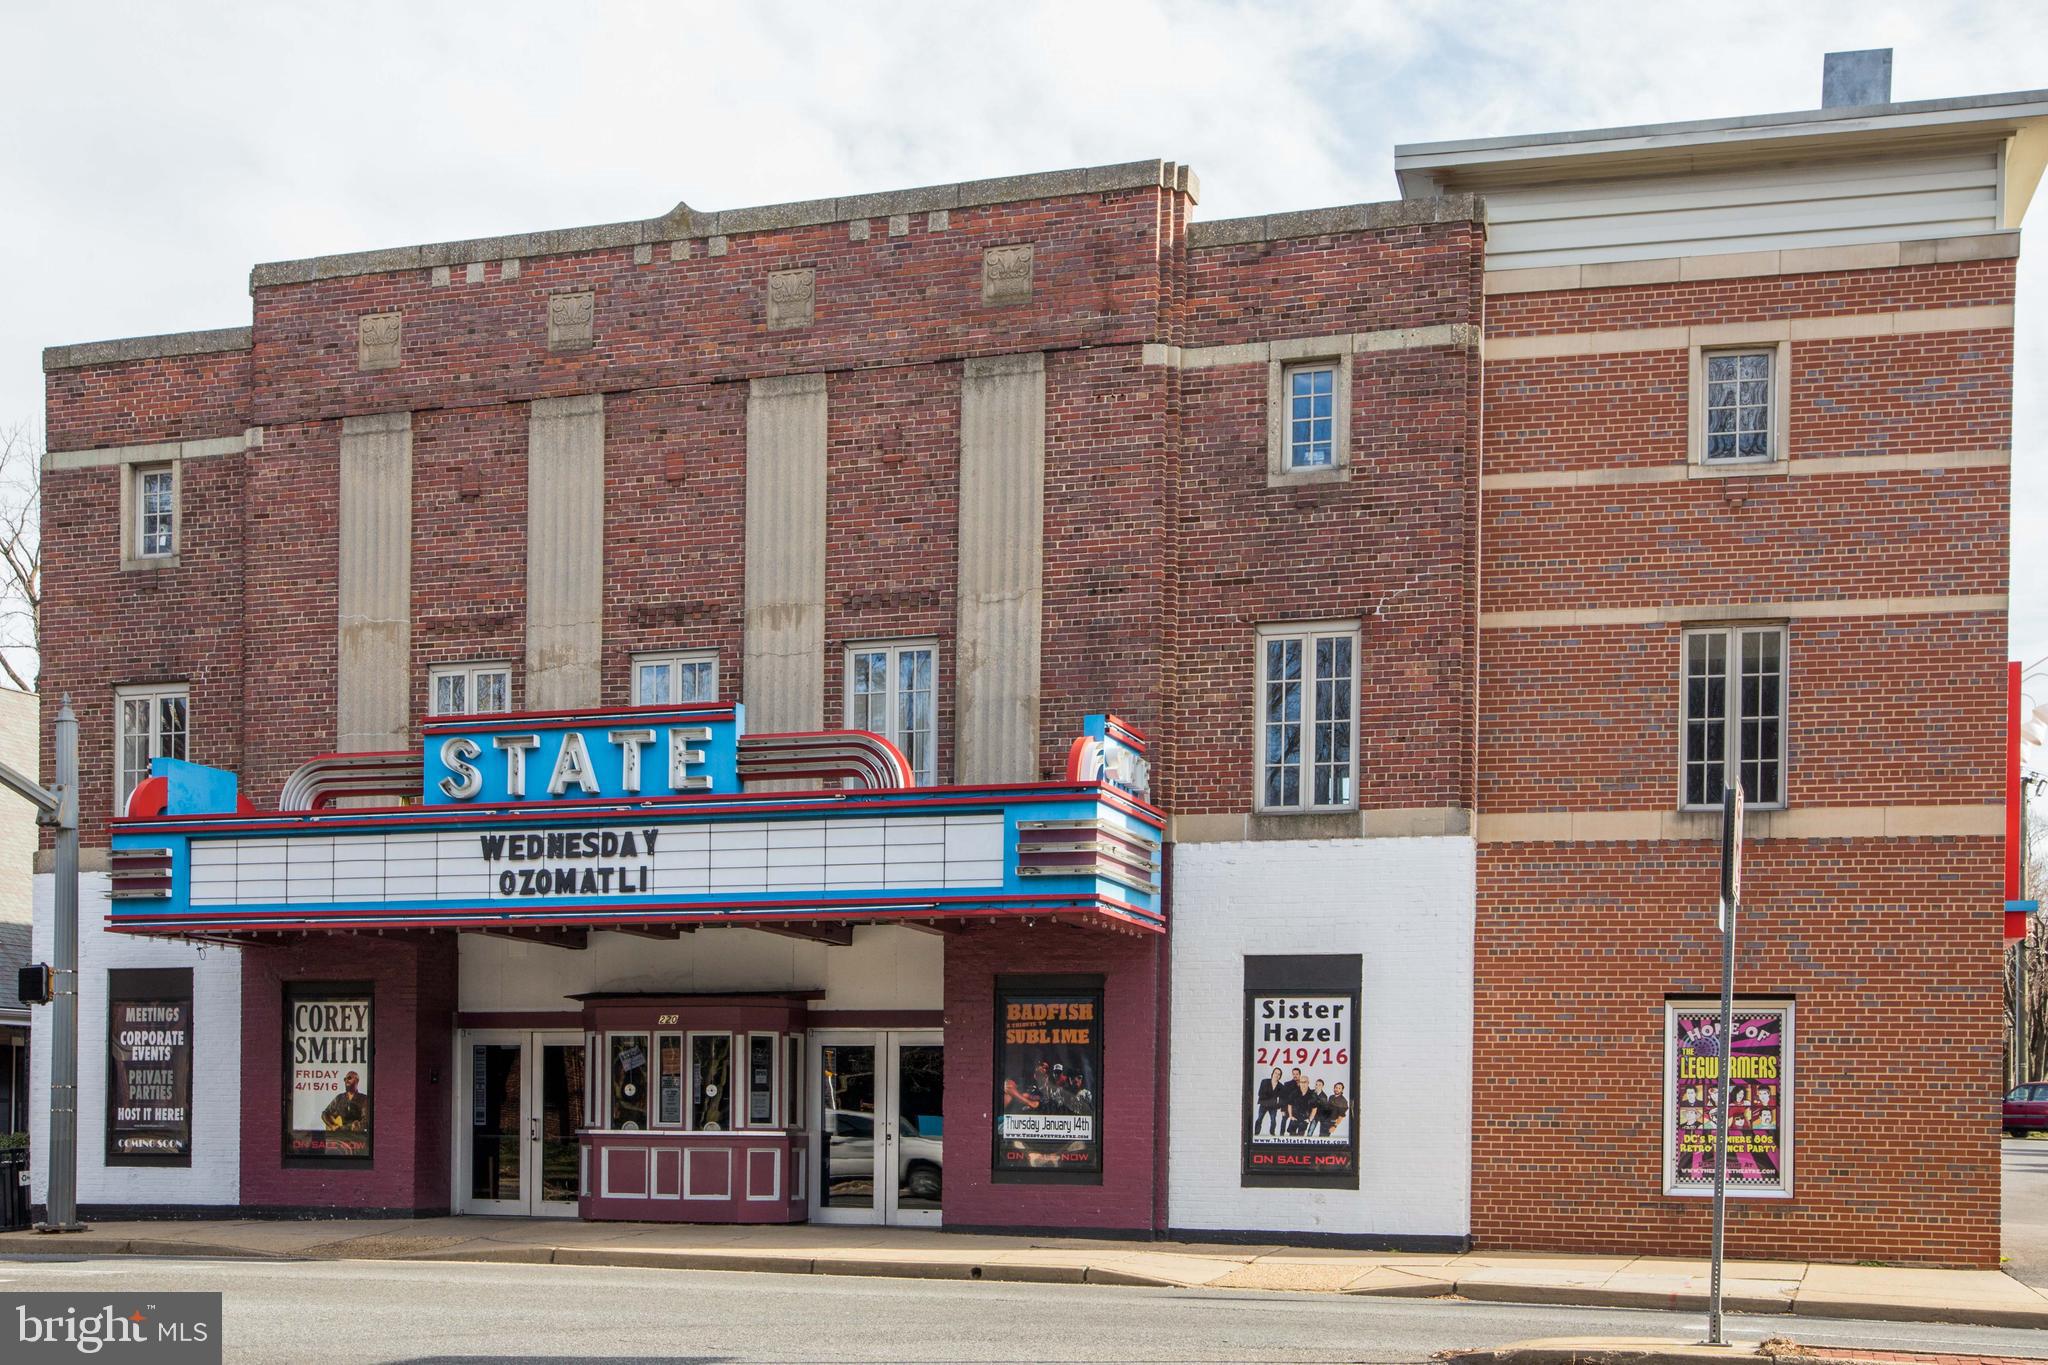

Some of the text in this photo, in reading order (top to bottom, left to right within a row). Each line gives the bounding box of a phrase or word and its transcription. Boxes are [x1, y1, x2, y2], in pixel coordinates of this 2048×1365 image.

[439, 727, 713, 800] STATE
[480, 829, 659, 861] WEDNESDAY
[499, 866, 648, 896] OZOMATLI
[125, 1007, 179, 1022] MEETINGS
[1007, 1003, 1093, 1020] BADFISH
[1262, 999, 1344, 1019] Sister
[295, 1004, 369, 1032] COREY
[658, 1015, 679, 1024] 220
[120, 1030, 184, 1046] CORPORATE
[1006, 1028, 1089, 1044] SUBLIME
[1264, 1022, 1341, 1041] Hazel
[1745, 1025, 1771, 1042] OF
[131, 1046, 171, 1061] EVENTS
[295, 1036, 367, 1064] SMITH
[1257, 1047, 1348, 1066] 2/19/16
[1682, 1047, 1695, 1056] THE
[295, 1070, 339, 1079] FRIDAY
[1680, 1056, 1777, 1079] LEGWRMERS
[128, 1070, 174, 1085] PRIVATE
[129, 1085, 173, 1100] PARTIES
[295, 1082, 339, 1091] 4/15/16
[118, 1107, 184, 1121] HOST IT HERE!
[1006, 1116, 1089, 1133] Thursday January 14th
[118, 1139, 183, 1148] COMING SOON
[1680, 1144, 1711, 1153] RETRO
[1747, 1144, 1777, 1153] PARTY
[1007, 1152, 1024, 1160] ON
[1061, 1153, 1088, 1161] NOW
[1253, 1155, 1347, 1165] ON SALE NOW
